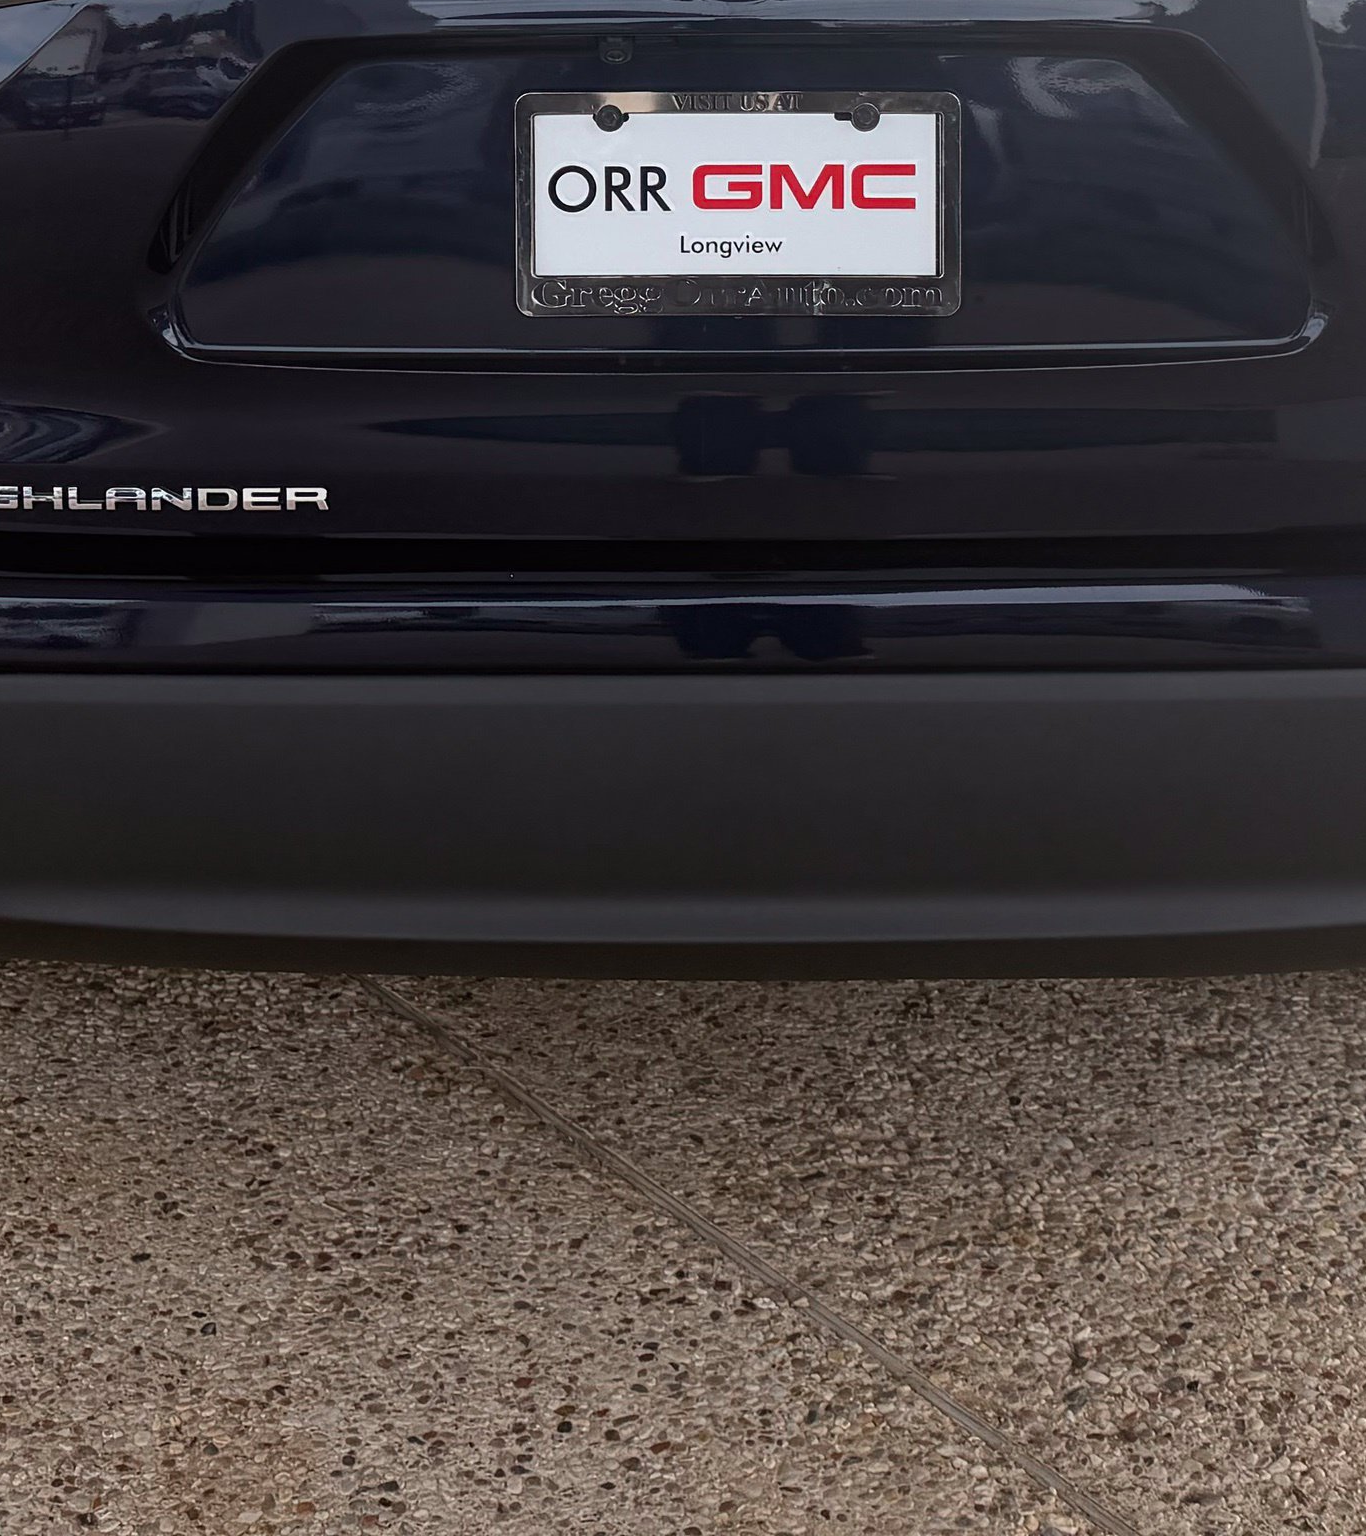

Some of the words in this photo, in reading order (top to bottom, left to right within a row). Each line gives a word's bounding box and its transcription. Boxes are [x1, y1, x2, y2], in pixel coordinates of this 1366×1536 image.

[671, 92, 733, 111] VISIT
[739, 92, 770, 112] US
[770, 91, 803, 111] AT
[547, 165, 673, 213] ORR
[692, 164, 917, 210] GMC
[680, 235, 784, 258] Longview
